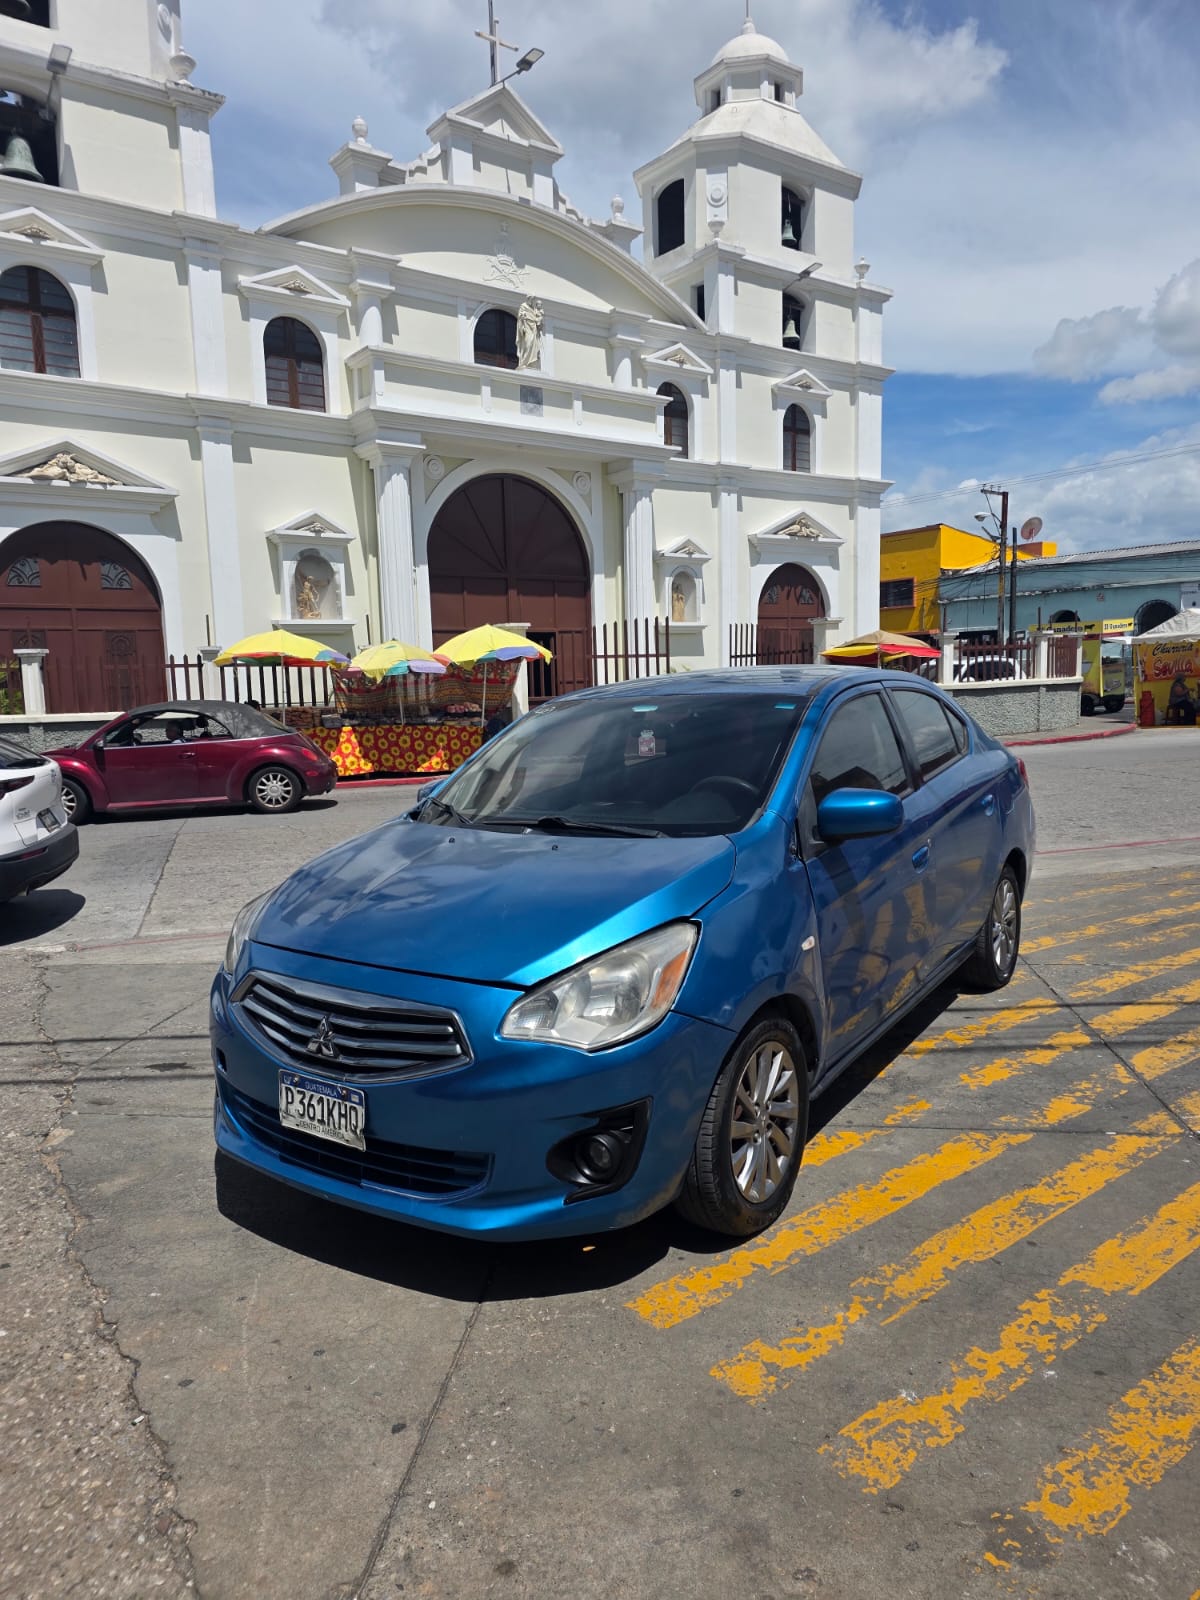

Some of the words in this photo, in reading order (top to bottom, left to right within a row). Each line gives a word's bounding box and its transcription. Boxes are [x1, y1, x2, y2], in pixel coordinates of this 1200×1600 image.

[1153, 657, 1194, 679] Sevilla
[305, 1082, 338, 1097] GUATEMALA
[285, 1086, 360, 1138] P361KHQ
